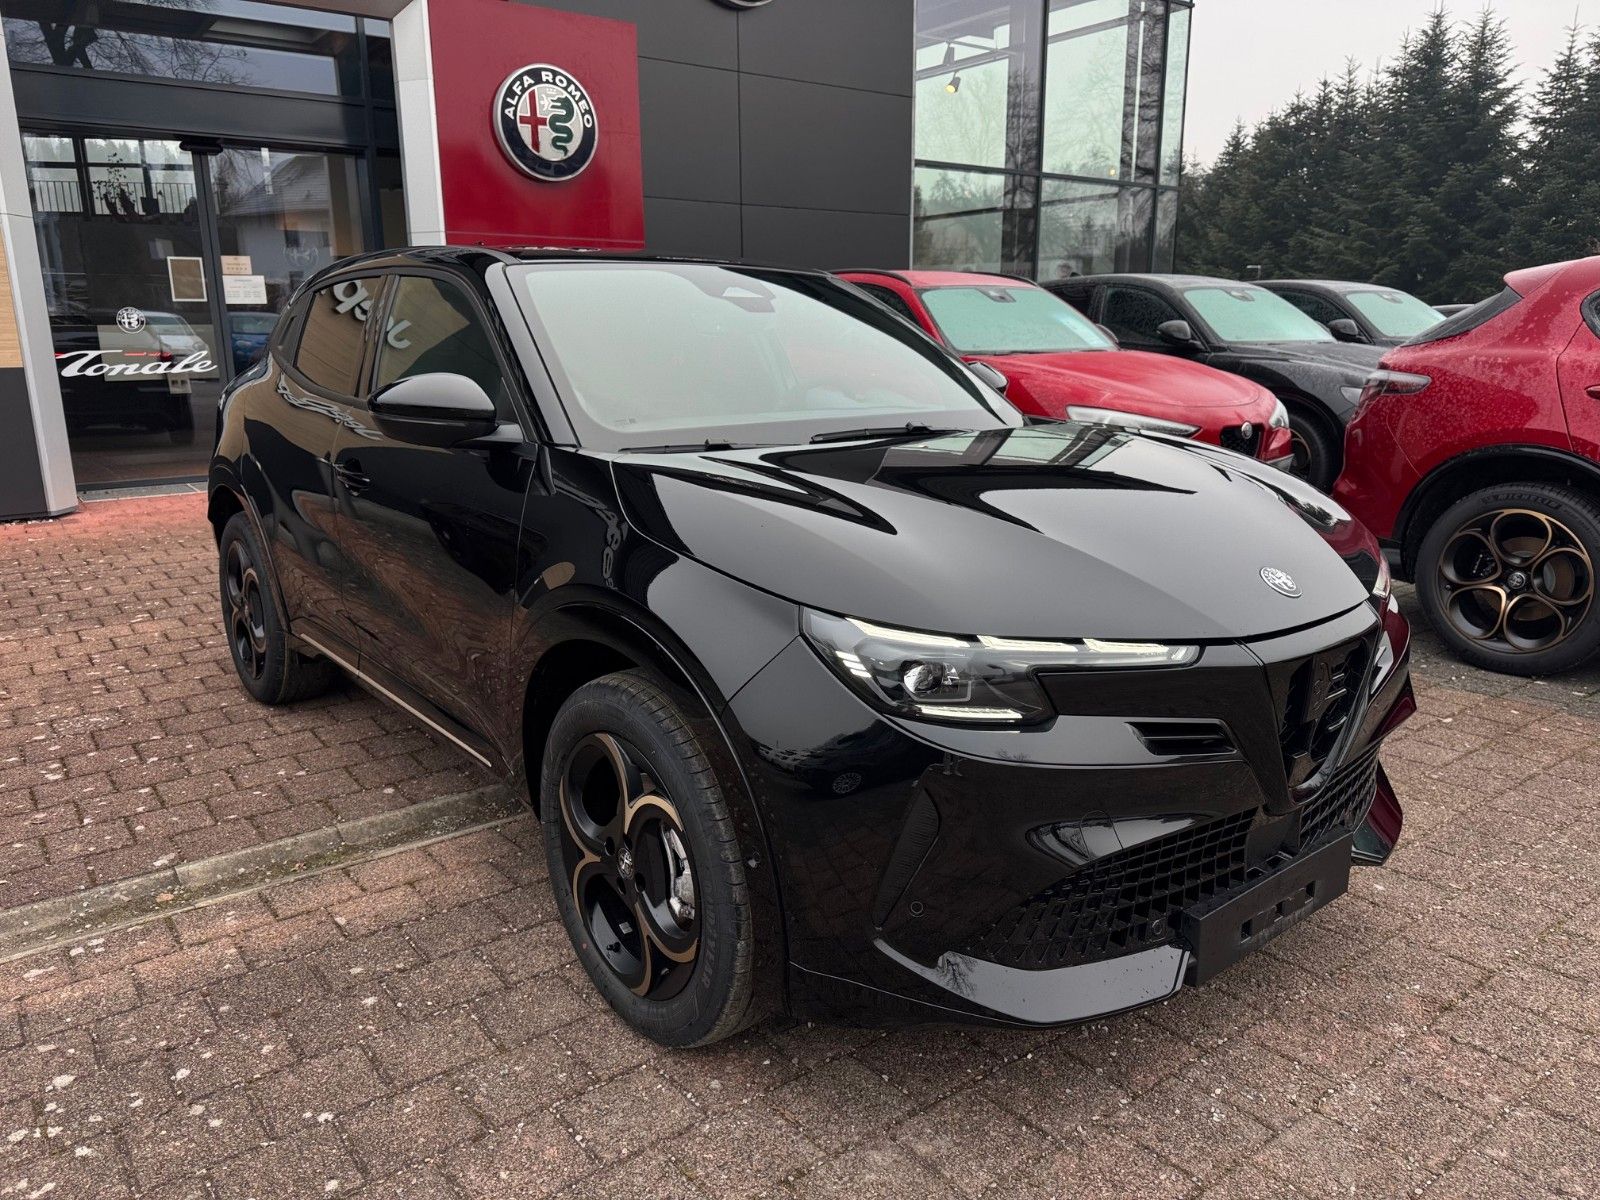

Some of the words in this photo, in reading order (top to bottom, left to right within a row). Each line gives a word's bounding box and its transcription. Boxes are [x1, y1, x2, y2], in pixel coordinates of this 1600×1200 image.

[504, 75, 535, 119] ALFA
[541, 71, 593, 128] ROMEO
[59, 350, 218, 378] Tonale
